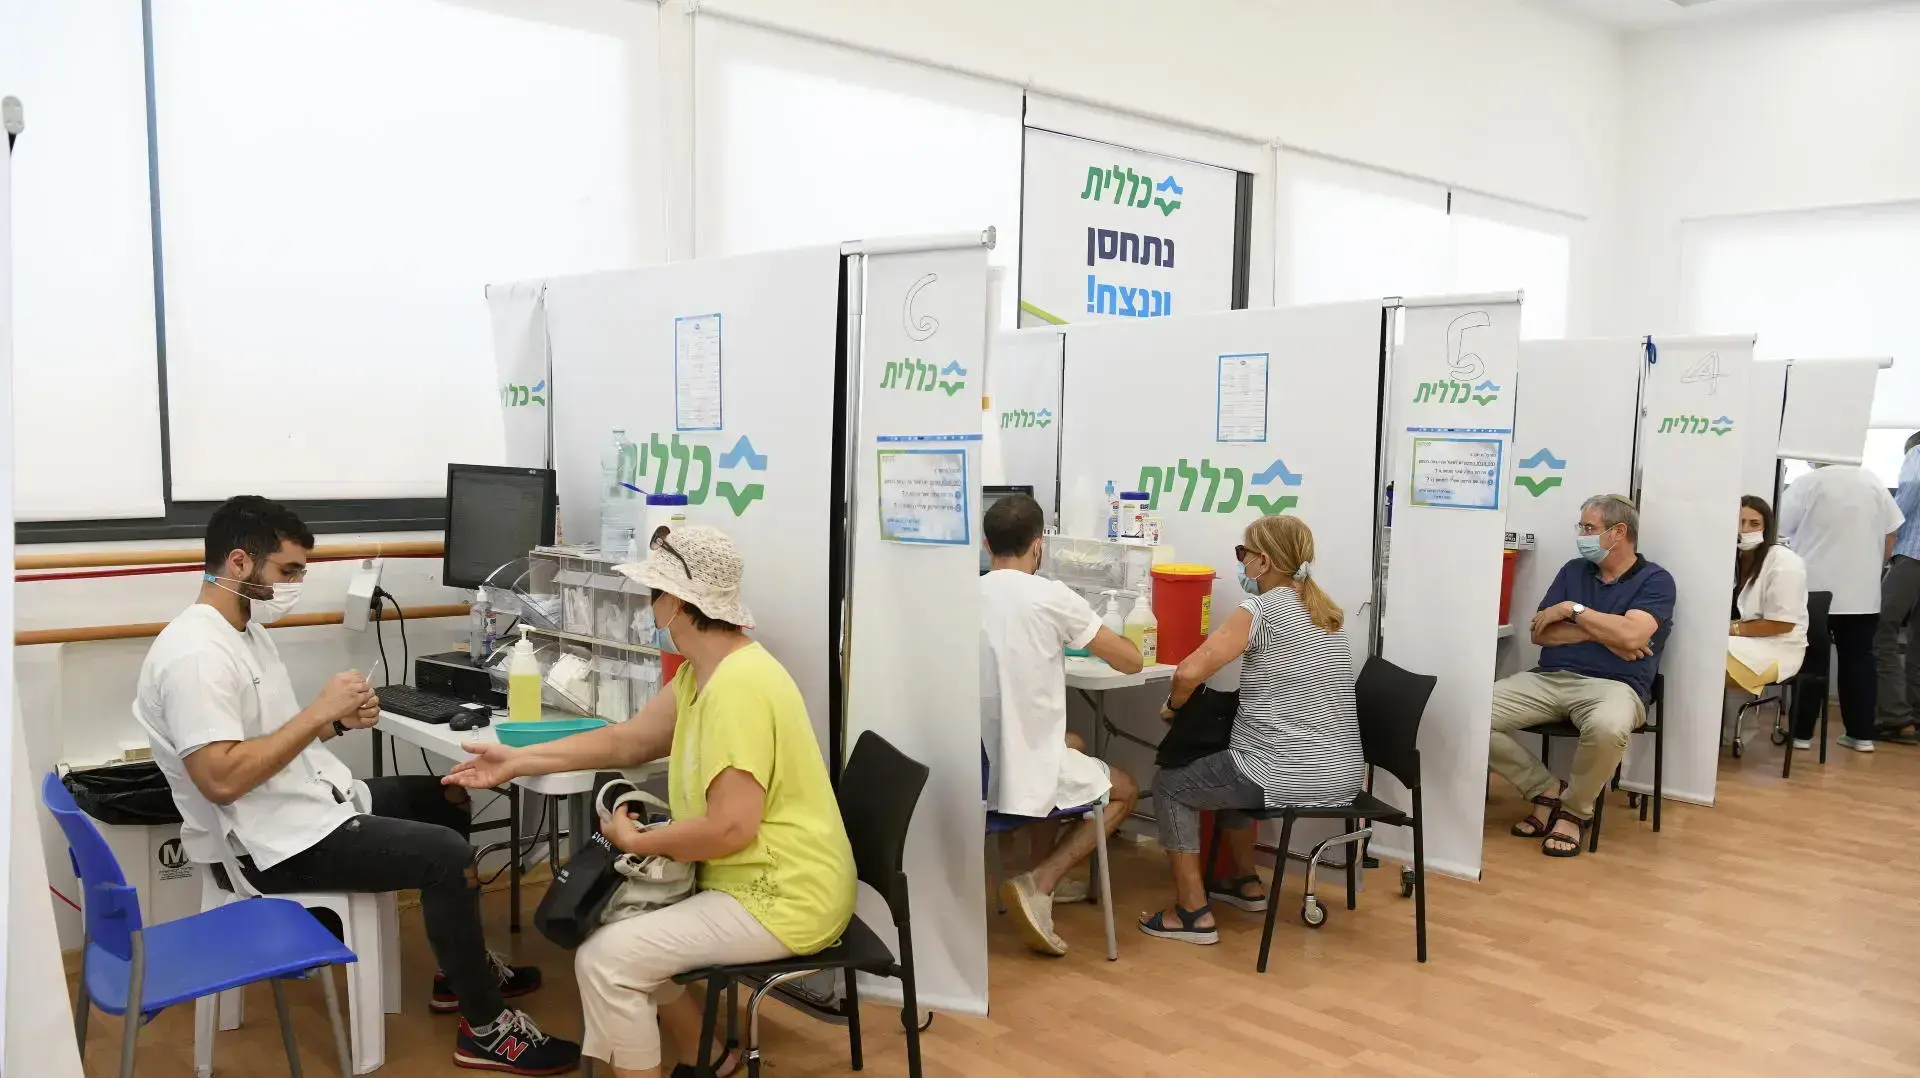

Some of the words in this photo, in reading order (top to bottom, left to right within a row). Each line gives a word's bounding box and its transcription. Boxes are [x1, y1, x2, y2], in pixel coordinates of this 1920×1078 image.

[1080, 164, 1153, 209] כללית
[1087, 226, 1175, 268] נתחסן
[902, 273, 940, 342] 6
[1086, 274, 1172, 318] וננצח!
[1446, 310, 1491, 382] 5
[880, 357, 938, 392] כללית
[1412, 379, 1473, 404] כללית
[1000, 408, 1036, 429] כללית
[1657, 415, 1710, 434] כללית
[495, 1035, 529, 1062] N
